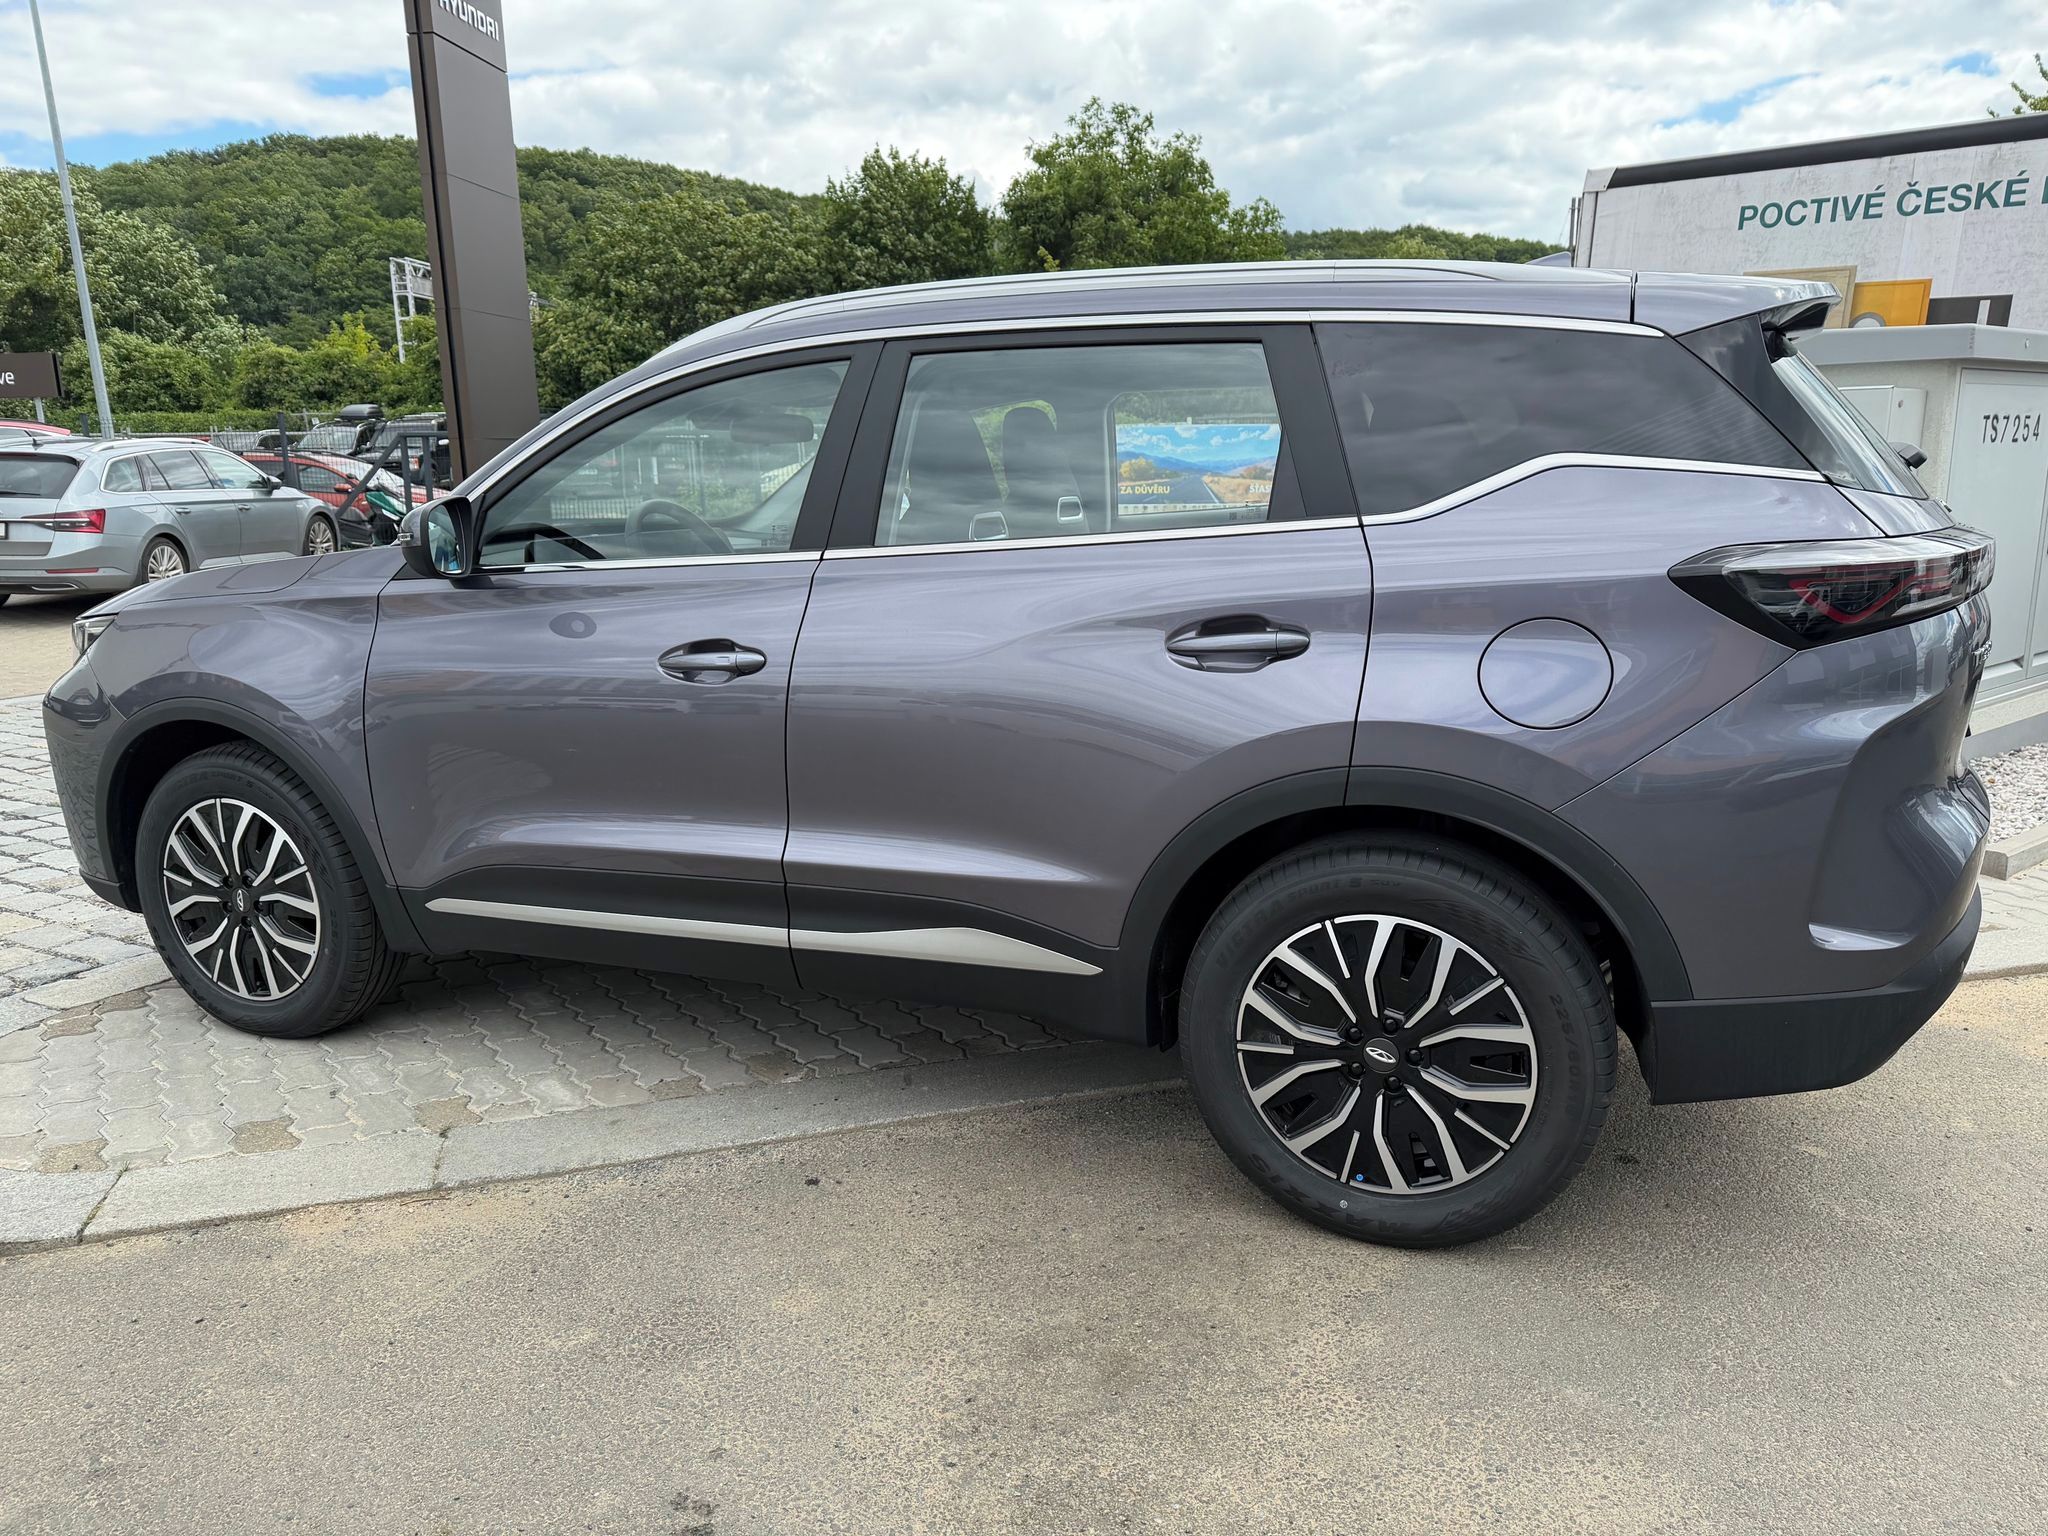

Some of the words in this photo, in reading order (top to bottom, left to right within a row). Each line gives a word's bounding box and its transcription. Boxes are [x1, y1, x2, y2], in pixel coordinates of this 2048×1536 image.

[1737, 184, 1886, 231] POCTIVÉ
[1896, 169, 2030, 217] ČESKÉ
[1120, 486, 1133, 494] ZA
